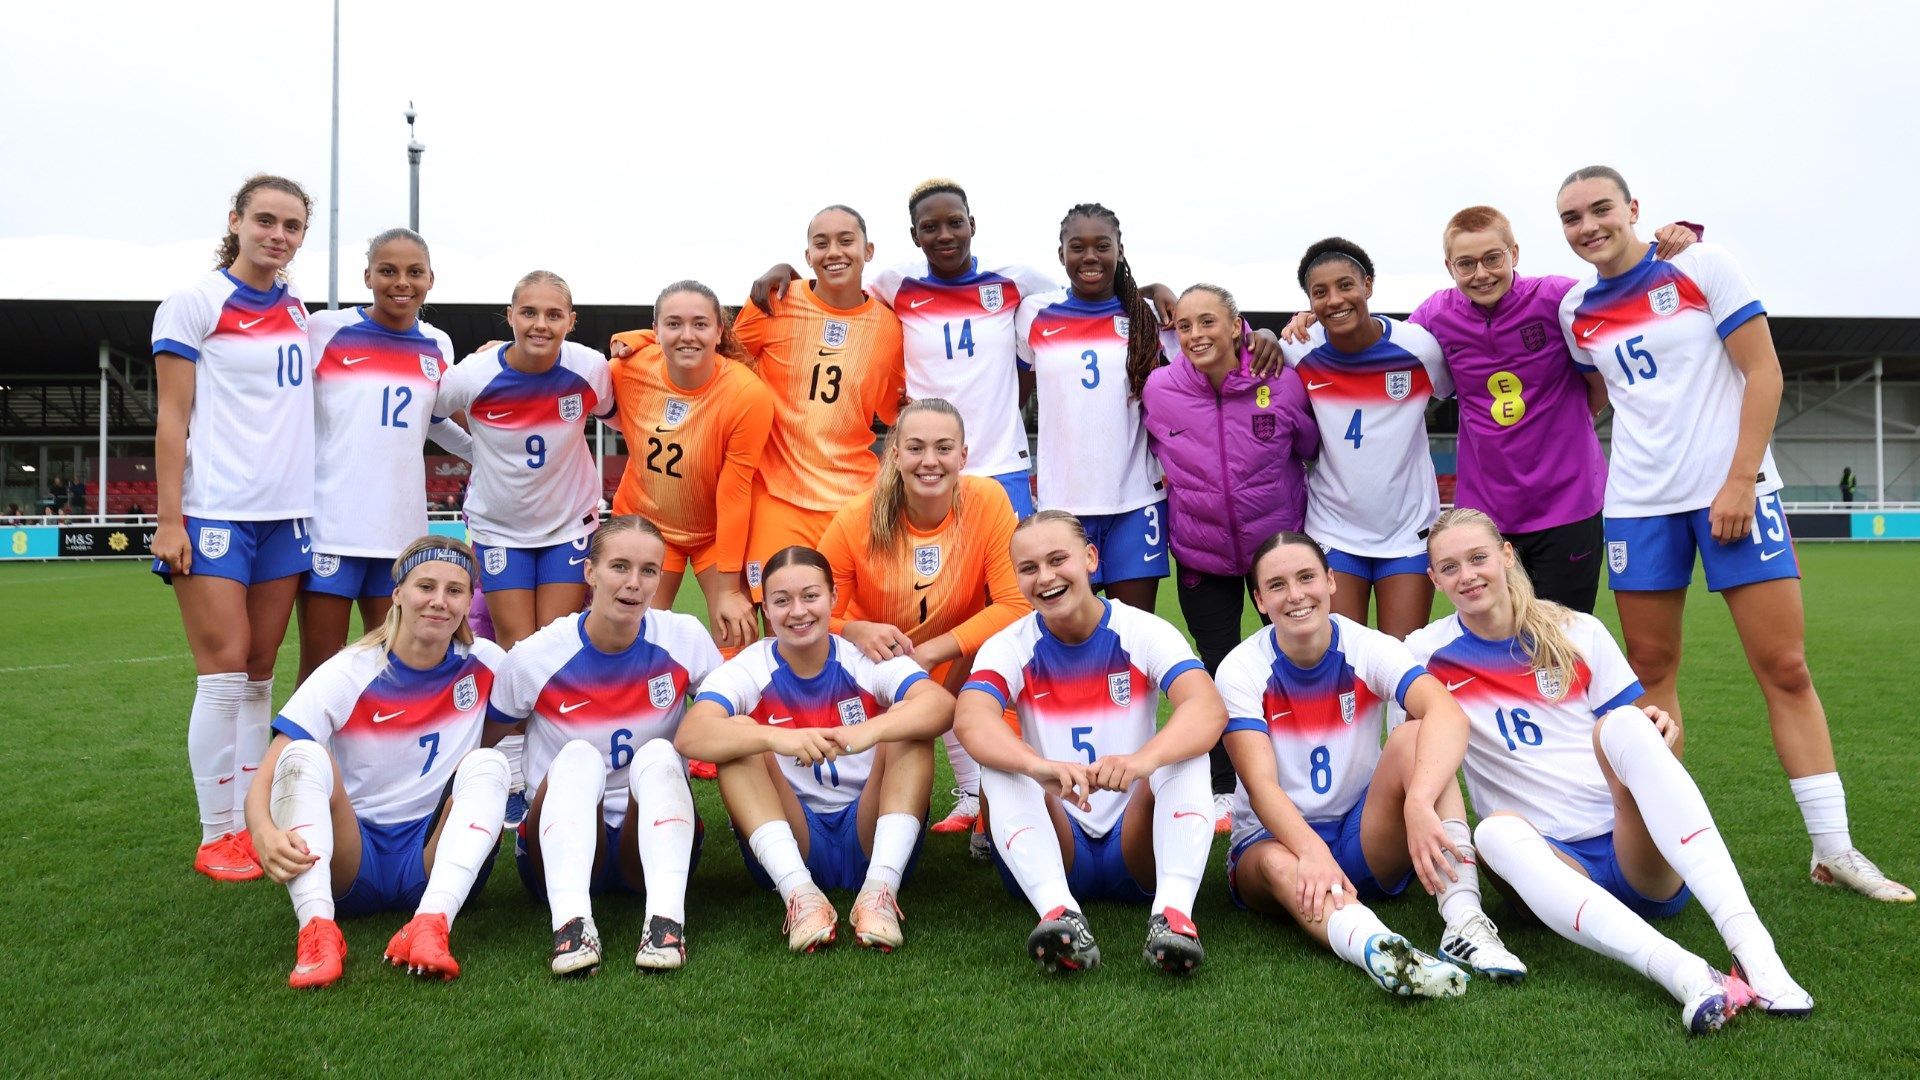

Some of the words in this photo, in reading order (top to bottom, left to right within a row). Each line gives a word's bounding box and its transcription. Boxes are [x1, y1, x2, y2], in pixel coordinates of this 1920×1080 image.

[944, 318, 975, 360] 14
[277, 343, 303, 387] 10
[1081, 349, 1100, 389] 3
[1615, 335, 1658, 386] 15
[809, 362, 842, 404] 13
[381, 385, 413, 428] 12
[1344, 408, 1364, 449] 4
[525, 434, 547, 469] 9
[647, 437, 684, 478] 22
[65, 534, 94, 545] M&S
[1144, 505, 1160, 546] 3
[1751, 495, 1785, 544] 15
[919, 595, 927, 624] 1
[609, 728, 634, 770] 6
[1071, 726, 1096, 765] 5
[1495, 707, 1543, 751] 16
[419, 732, 440, 778] 7
[1310, 745, 1332, 795] 8
